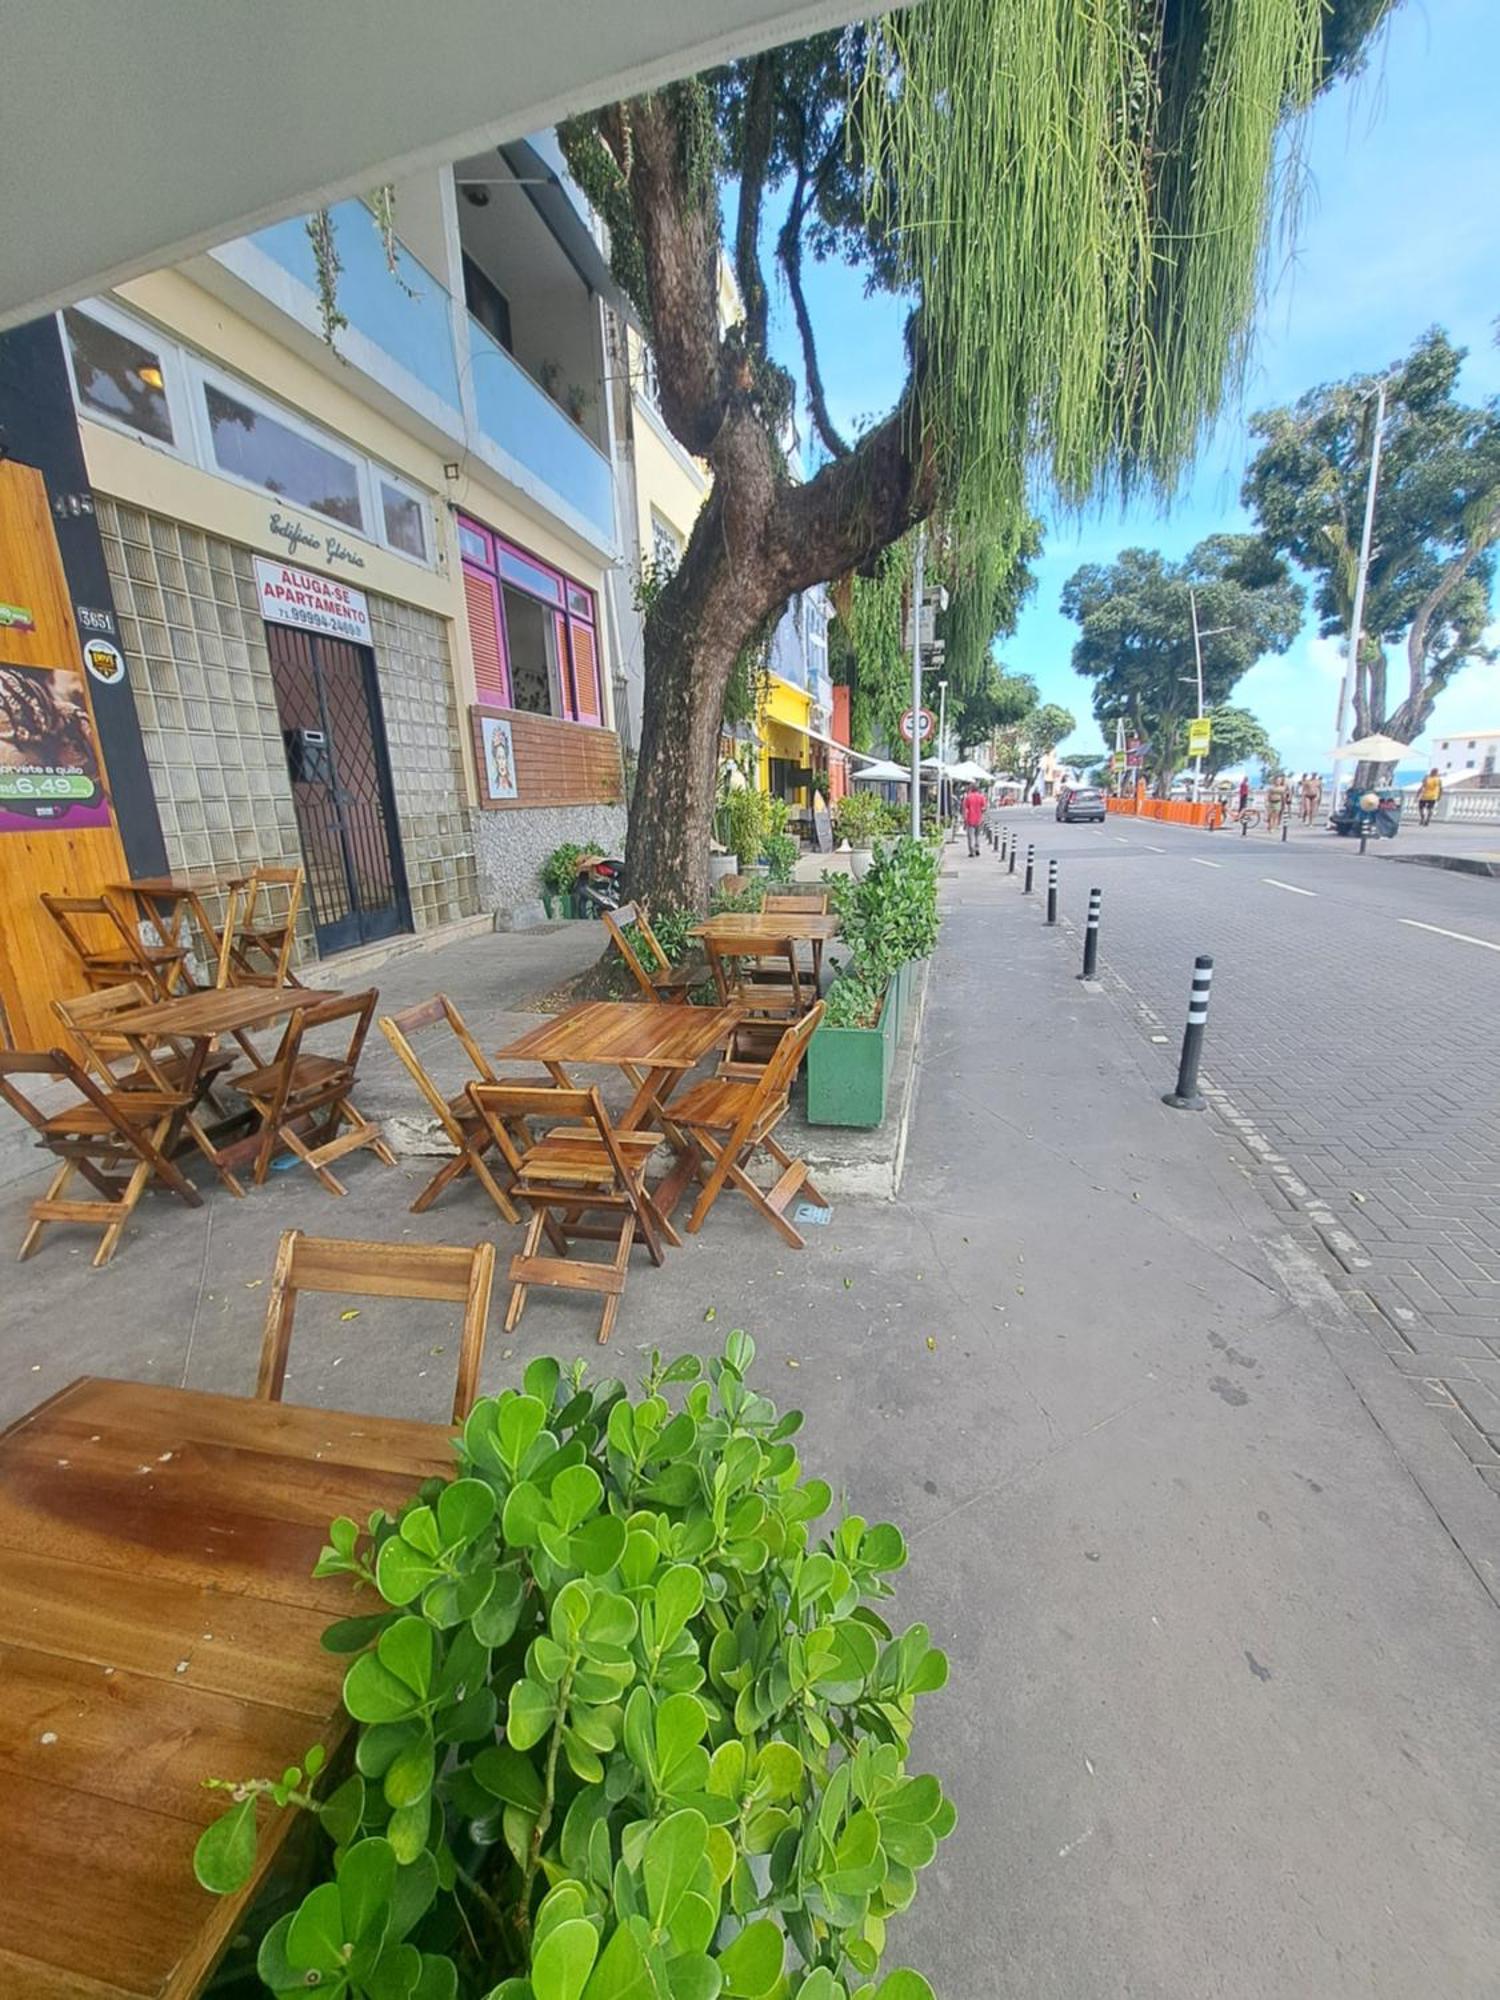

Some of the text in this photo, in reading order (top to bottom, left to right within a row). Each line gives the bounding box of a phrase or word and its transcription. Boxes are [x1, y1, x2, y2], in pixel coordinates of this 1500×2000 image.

[282, 570, 351, 604] ALUGA-SE
[264, 582, 366, 624] APARTAMENTO
[906, 714, 929, 730] 30
[45, 766, 53, 774] a
[55, 766, 83, 776] quilo
